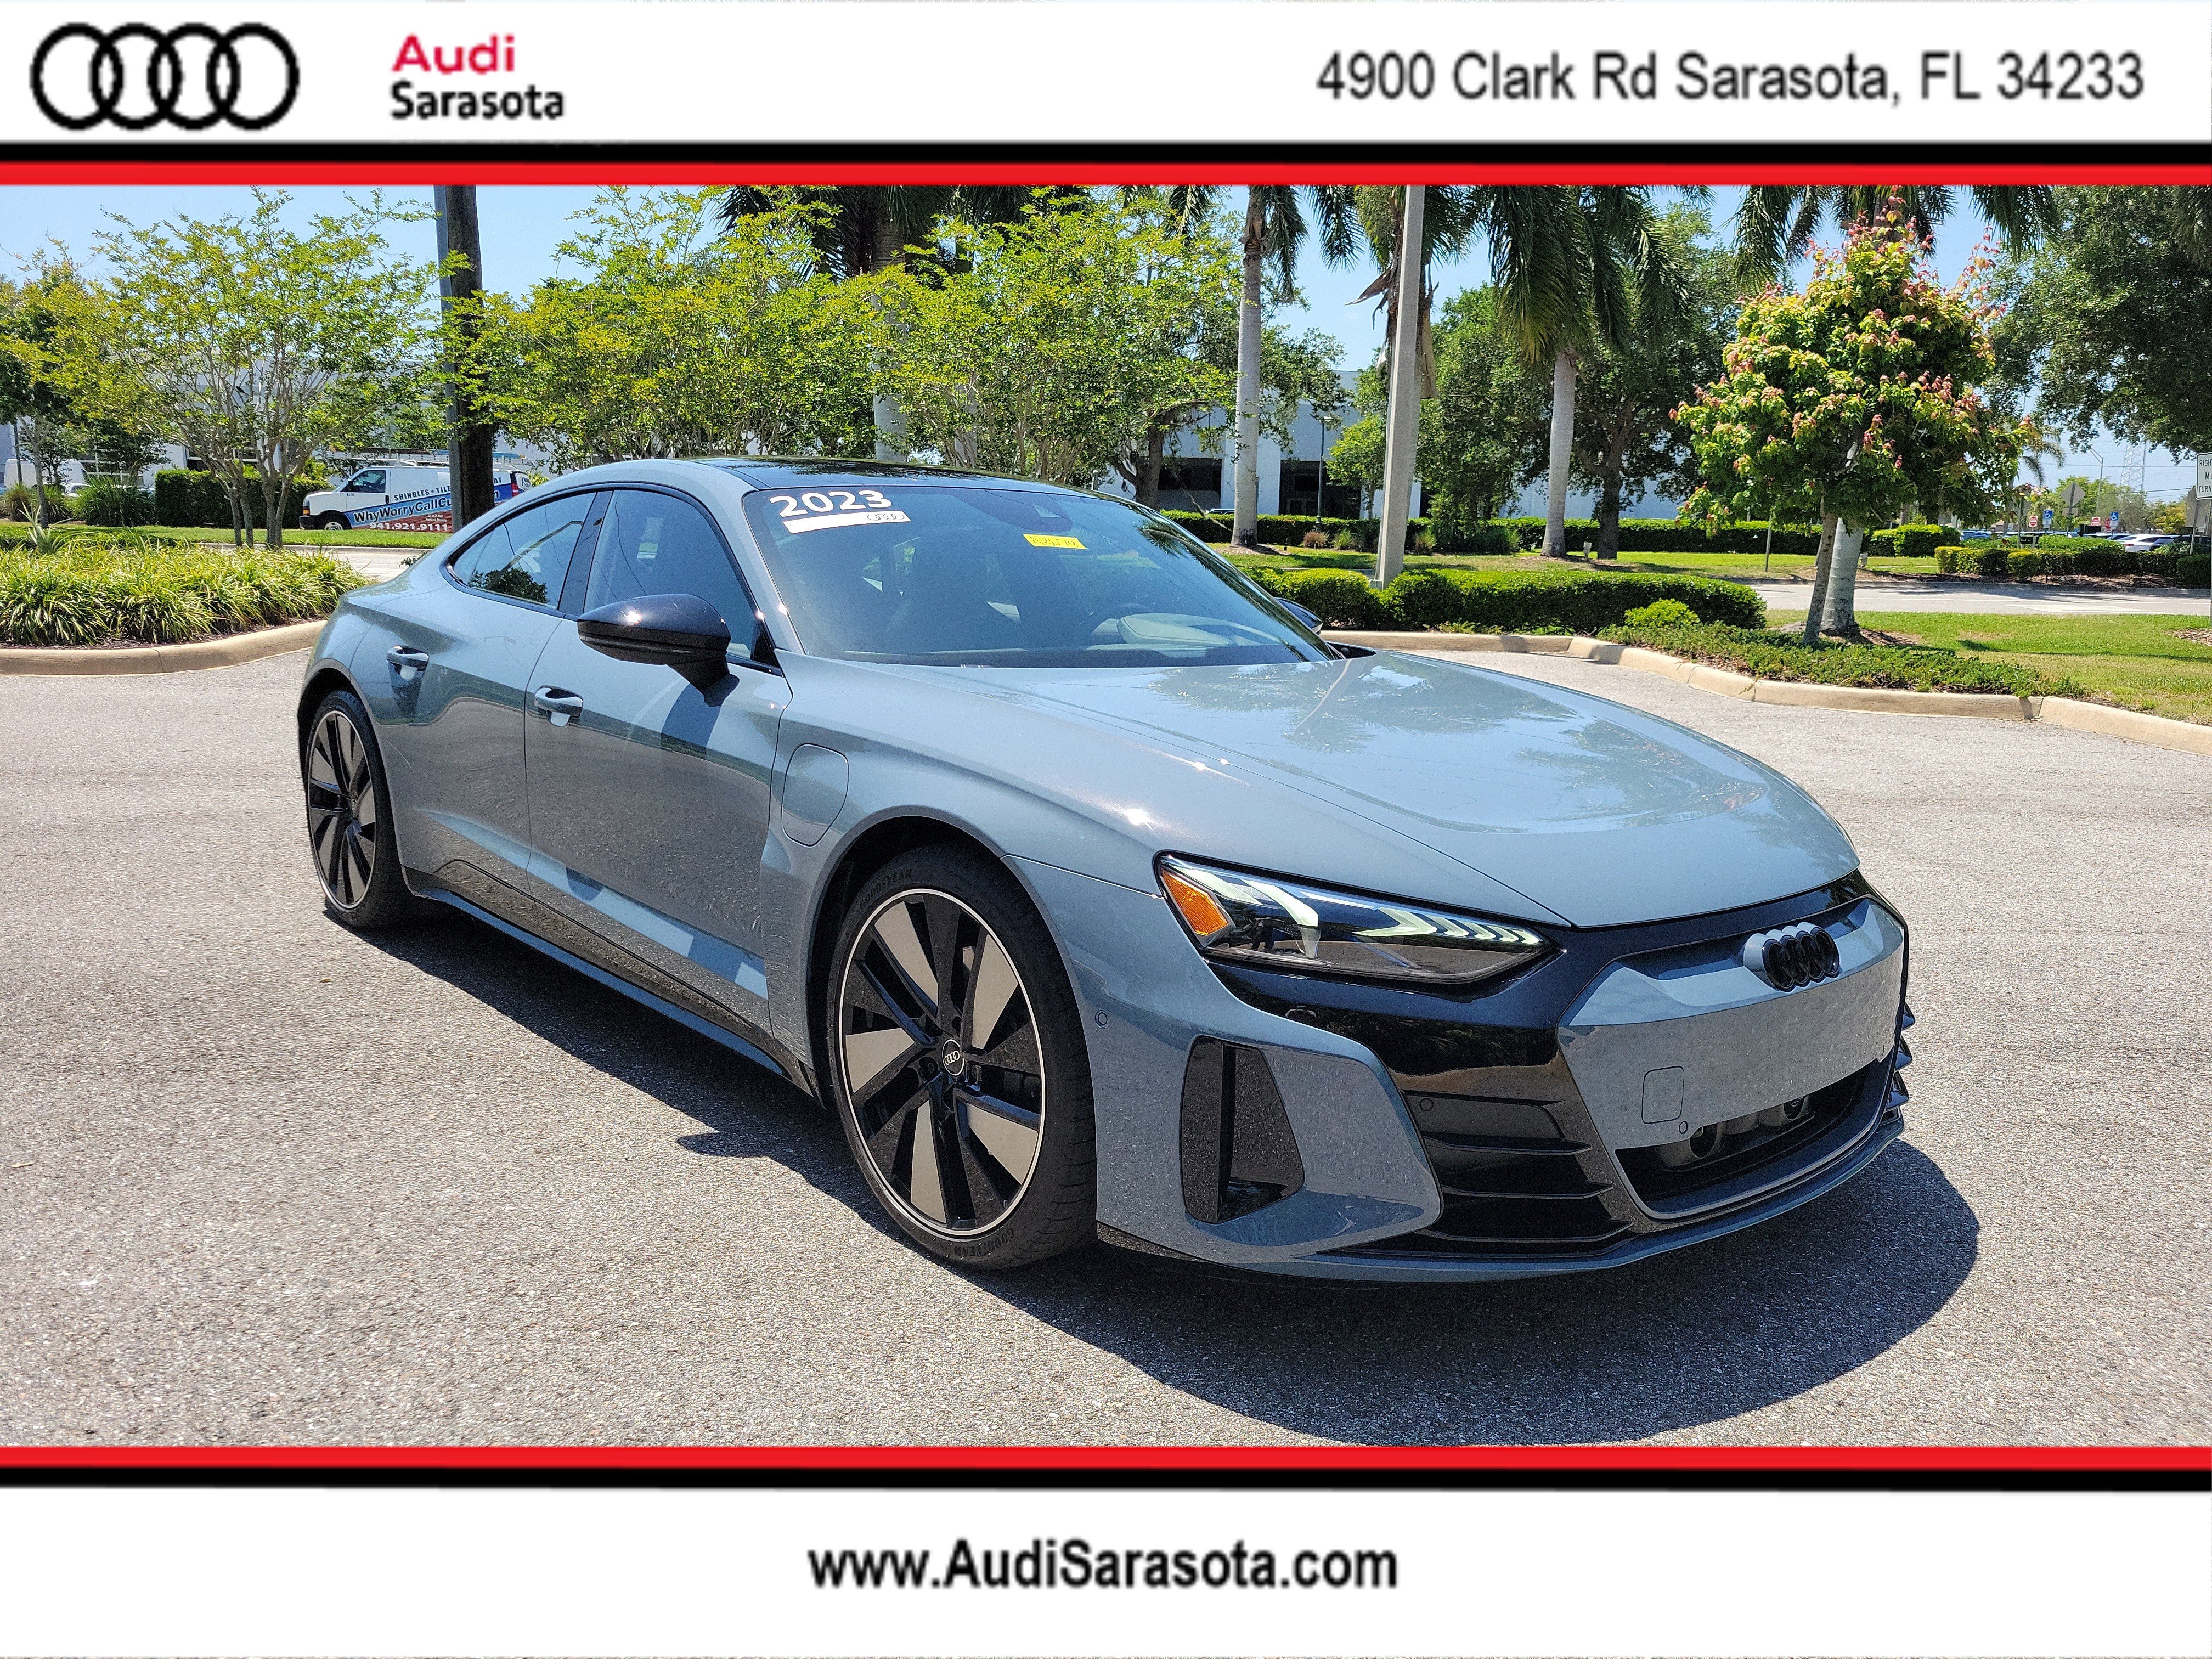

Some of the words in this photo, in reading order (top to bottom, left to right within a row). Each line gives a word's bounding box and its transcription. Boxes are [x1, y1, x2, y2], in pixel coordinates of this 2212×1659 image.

[2199, 459, 2212, 467] RIGH
[394, 489, 430, 501] SHINGLES
[769, 490, 892, 518] 2023
[369, 522, 448, 531] 941.921.9111
[859, 868, 912, 911] GOODYEAR
[955, 1227, 1015, 1257] GOODYEAR
